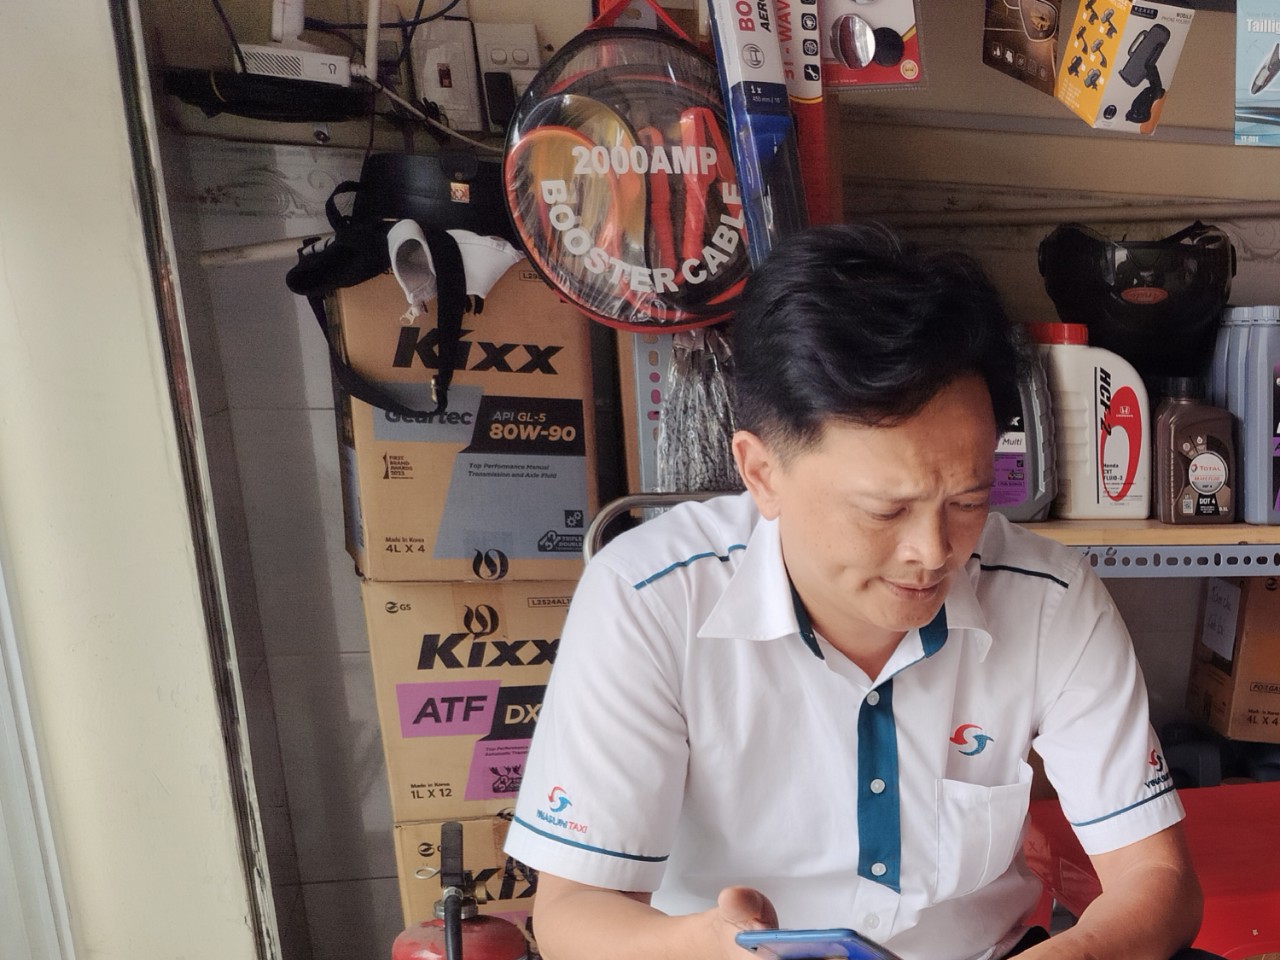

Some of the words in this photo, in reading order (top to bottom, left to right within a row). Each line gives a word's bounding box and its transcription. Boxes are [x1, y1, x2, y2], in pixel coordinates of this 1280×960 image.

[572, 145, 718, 175] 2000AMP
[541, 179, 679, 294] BOOSTER
[682, 181, 746, 285] CABLE
[492, 411, 515, 421] API
[517, 412, 547, 422] GL-5
[489, 423, 576, 442] 80W-90
[1002, 438, 1023, 446] Multi
[469, 462, 482, 470] Top
[483, 463, 525, 471] Performance
[468, 471, 510, 479] Transmission
[1199, 497, 1211, 505] DOT
[385, 544, 401, 553] 4L
[416, 545, 426, 553] 4
[416, 632, 561, 670] Kixx
[412, 695, 488, 725] ATF
[1271, 717, 1279, 726] 4
[410, 789, 424, 799] 1L
[439, 788, 453, 798] 12
[568, 821, 588, 834] TAXI
